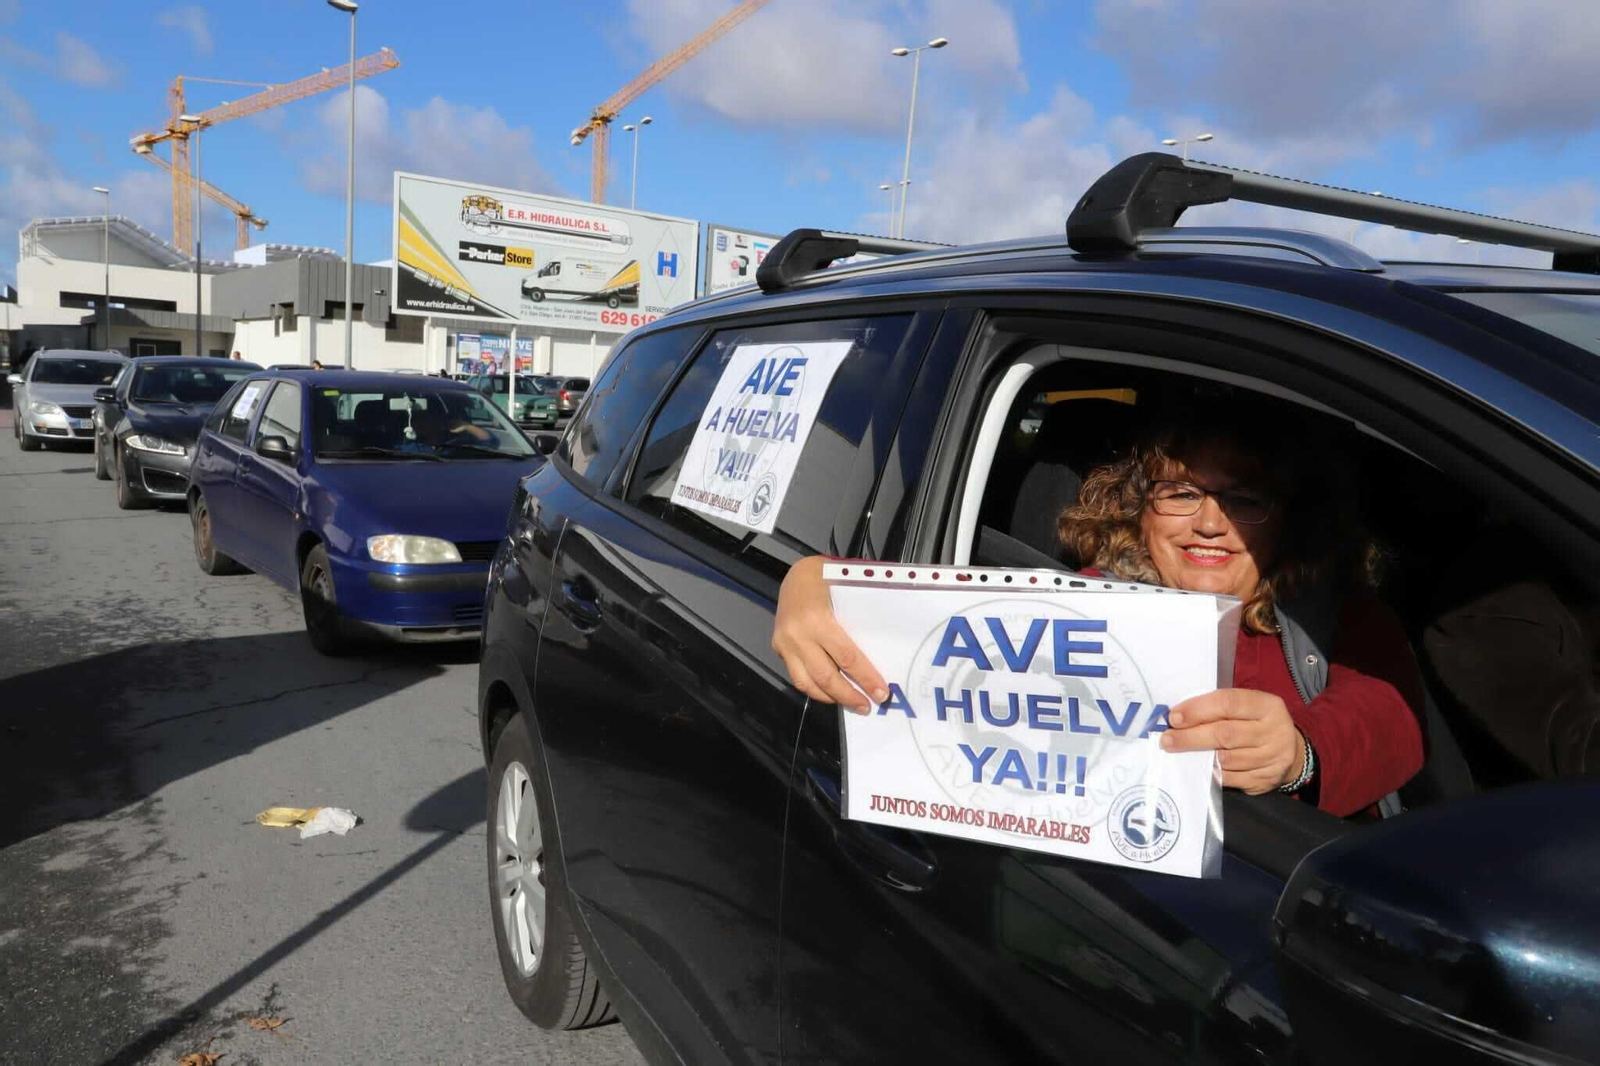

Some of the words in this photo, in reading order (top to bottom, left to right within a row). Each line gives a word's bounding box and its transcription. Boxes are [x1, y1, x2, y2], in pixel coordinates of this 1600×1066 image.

[507, 209, 527, 220] E.R.
[530, 212, 590, 230] HIDRAULICA
[593, 222, 610, 233] S.L.
[468, 246, 505, 262] Parker
[507, 251, 532, 265] Store
[406, 299, 475, 312] www.erhidraulica.es
[600, 310, 628, 326] 629
[739, 358, 809, 396] AVE
[705, 406, 722, 431] A
[721, 407, 800, 443] HUELVA
[714, 448, 757, 482] YA!!!
[931, 616, 1108, 678] AVE
[876, 682, 917, 719] A
[933, 686, 1171, 739] HUELVA
[957, 743, 1088, 797] YA!!!
[869, 794, 927, 818] JUNTOS
[929, 802, 985, 828] SOMOS
[987, 810, 1091, 845] IMPARABLES
